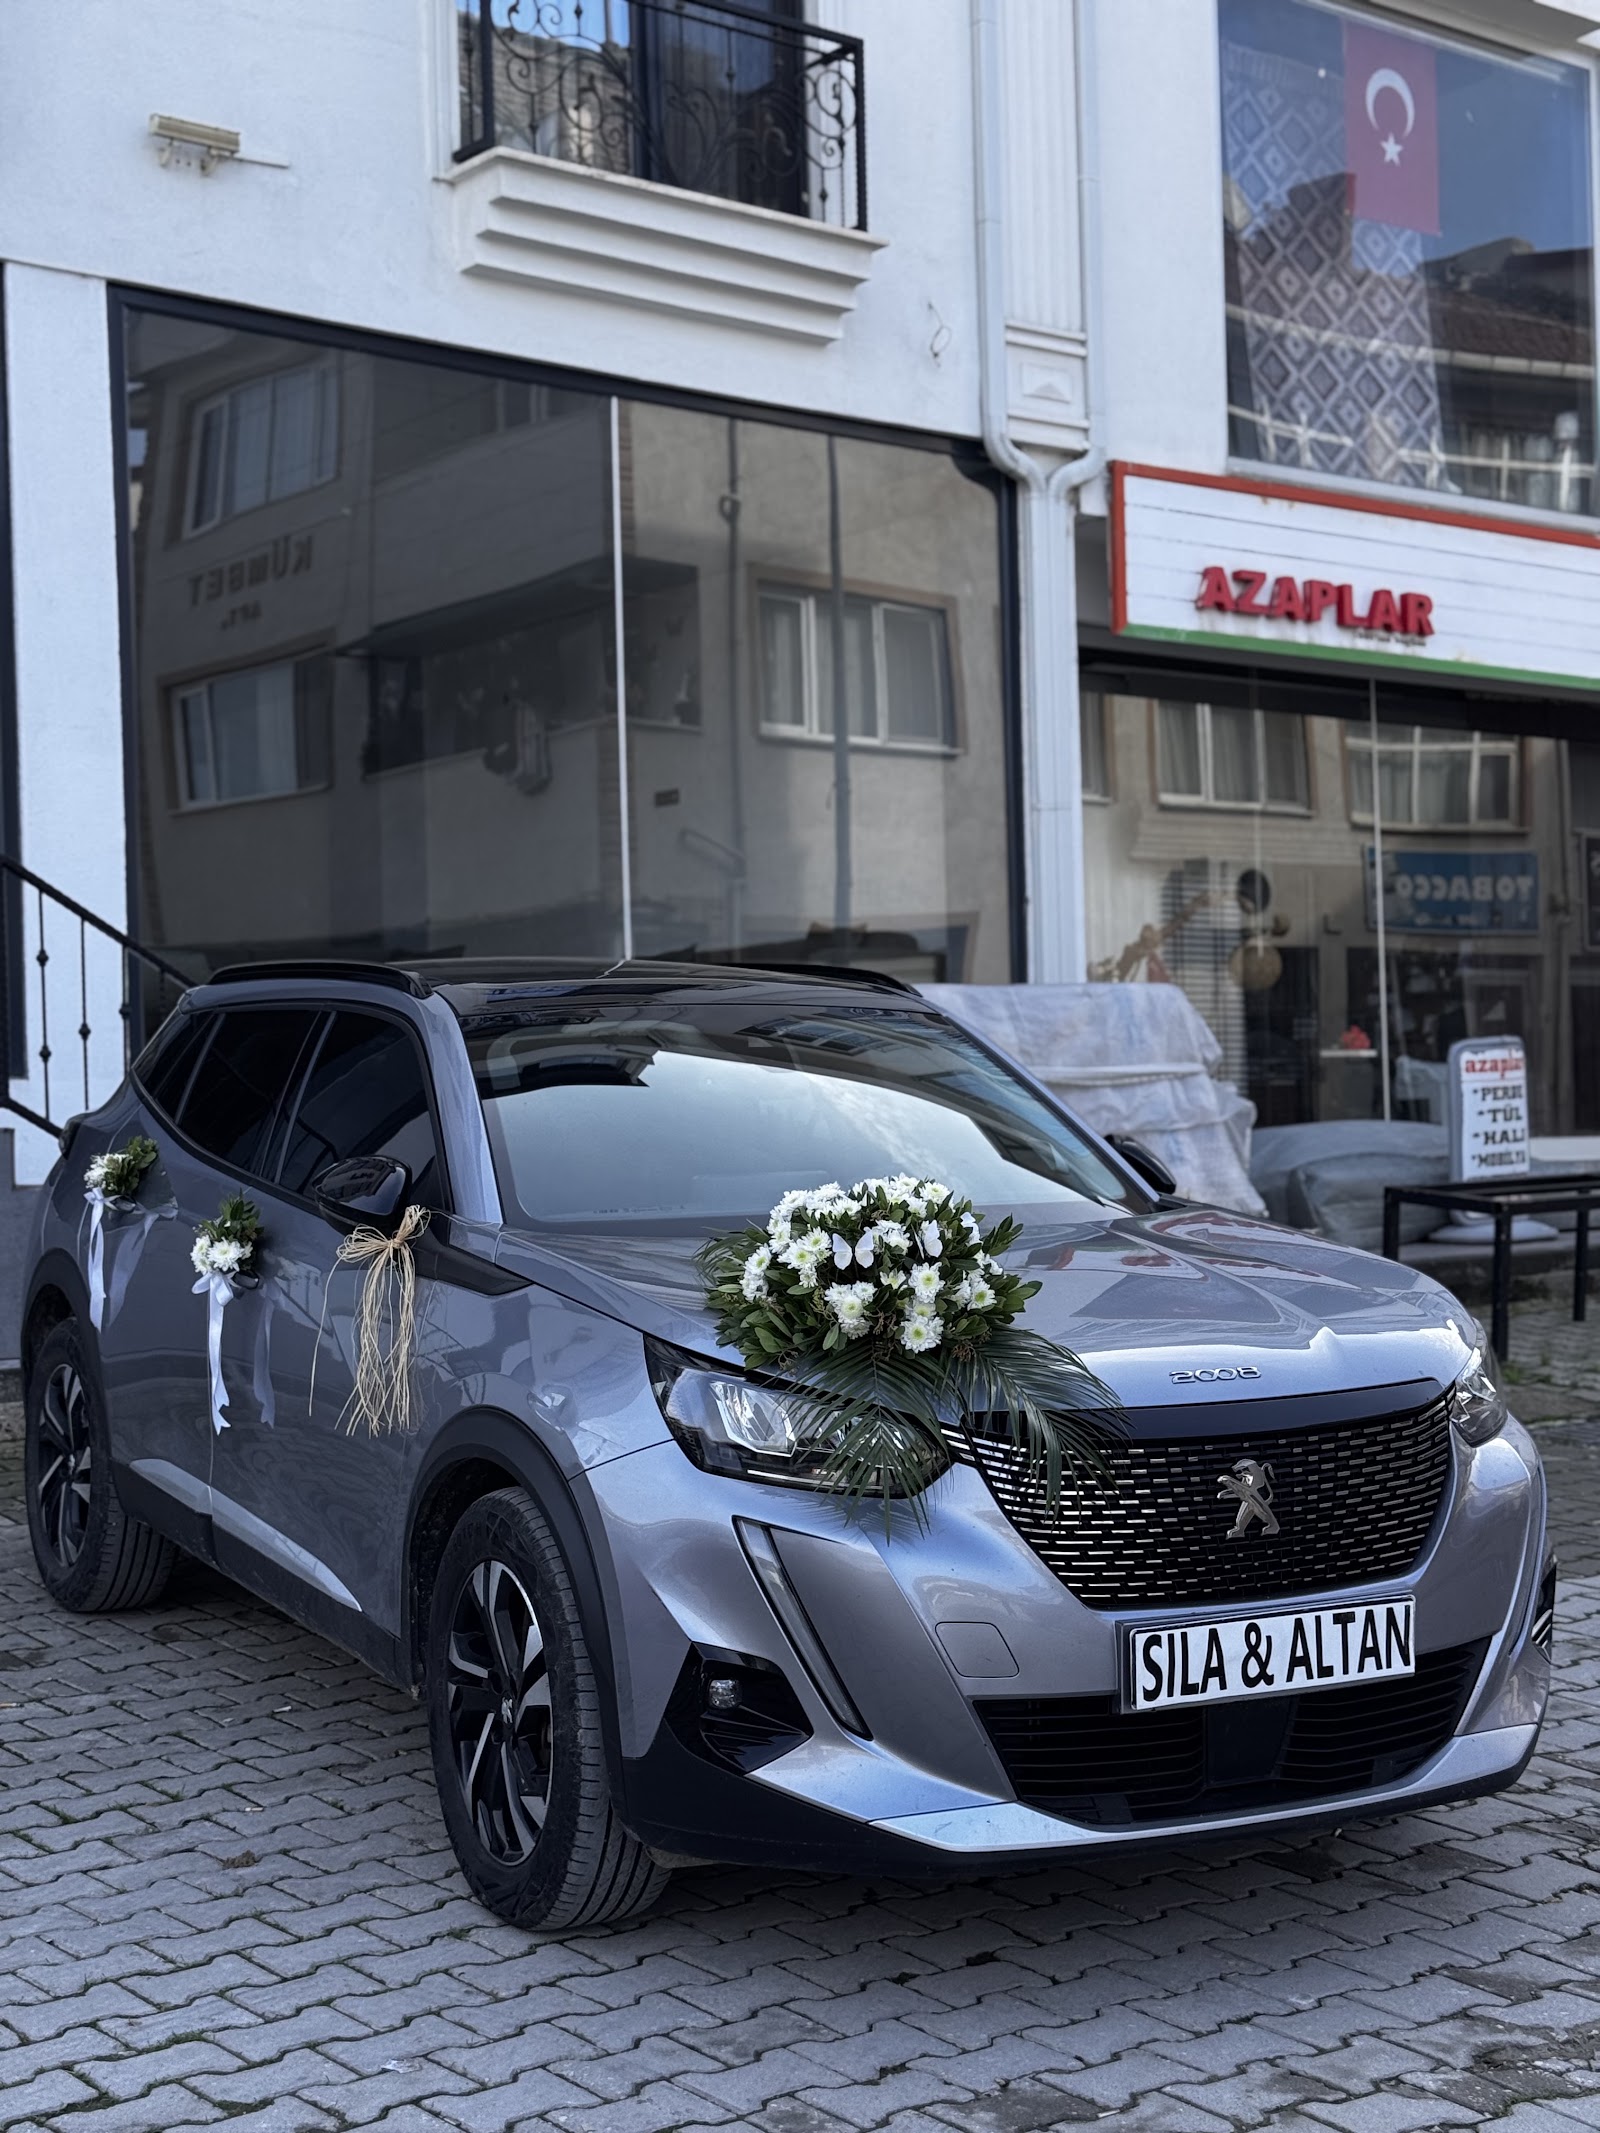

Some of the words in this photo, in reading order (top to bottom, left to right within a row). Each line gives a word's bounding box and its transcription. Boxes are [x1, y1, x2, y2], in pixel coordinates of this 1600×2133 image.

[1196, 566, 1435, 636] AZAPLAR
[1169, 1366, 1261, 1384] 2008
[1142, 1628, 1228, 1702] SILA
[1241, 1622, 1274, 1688] &
[1286, 1604, 1411, 1683] ALTAN
